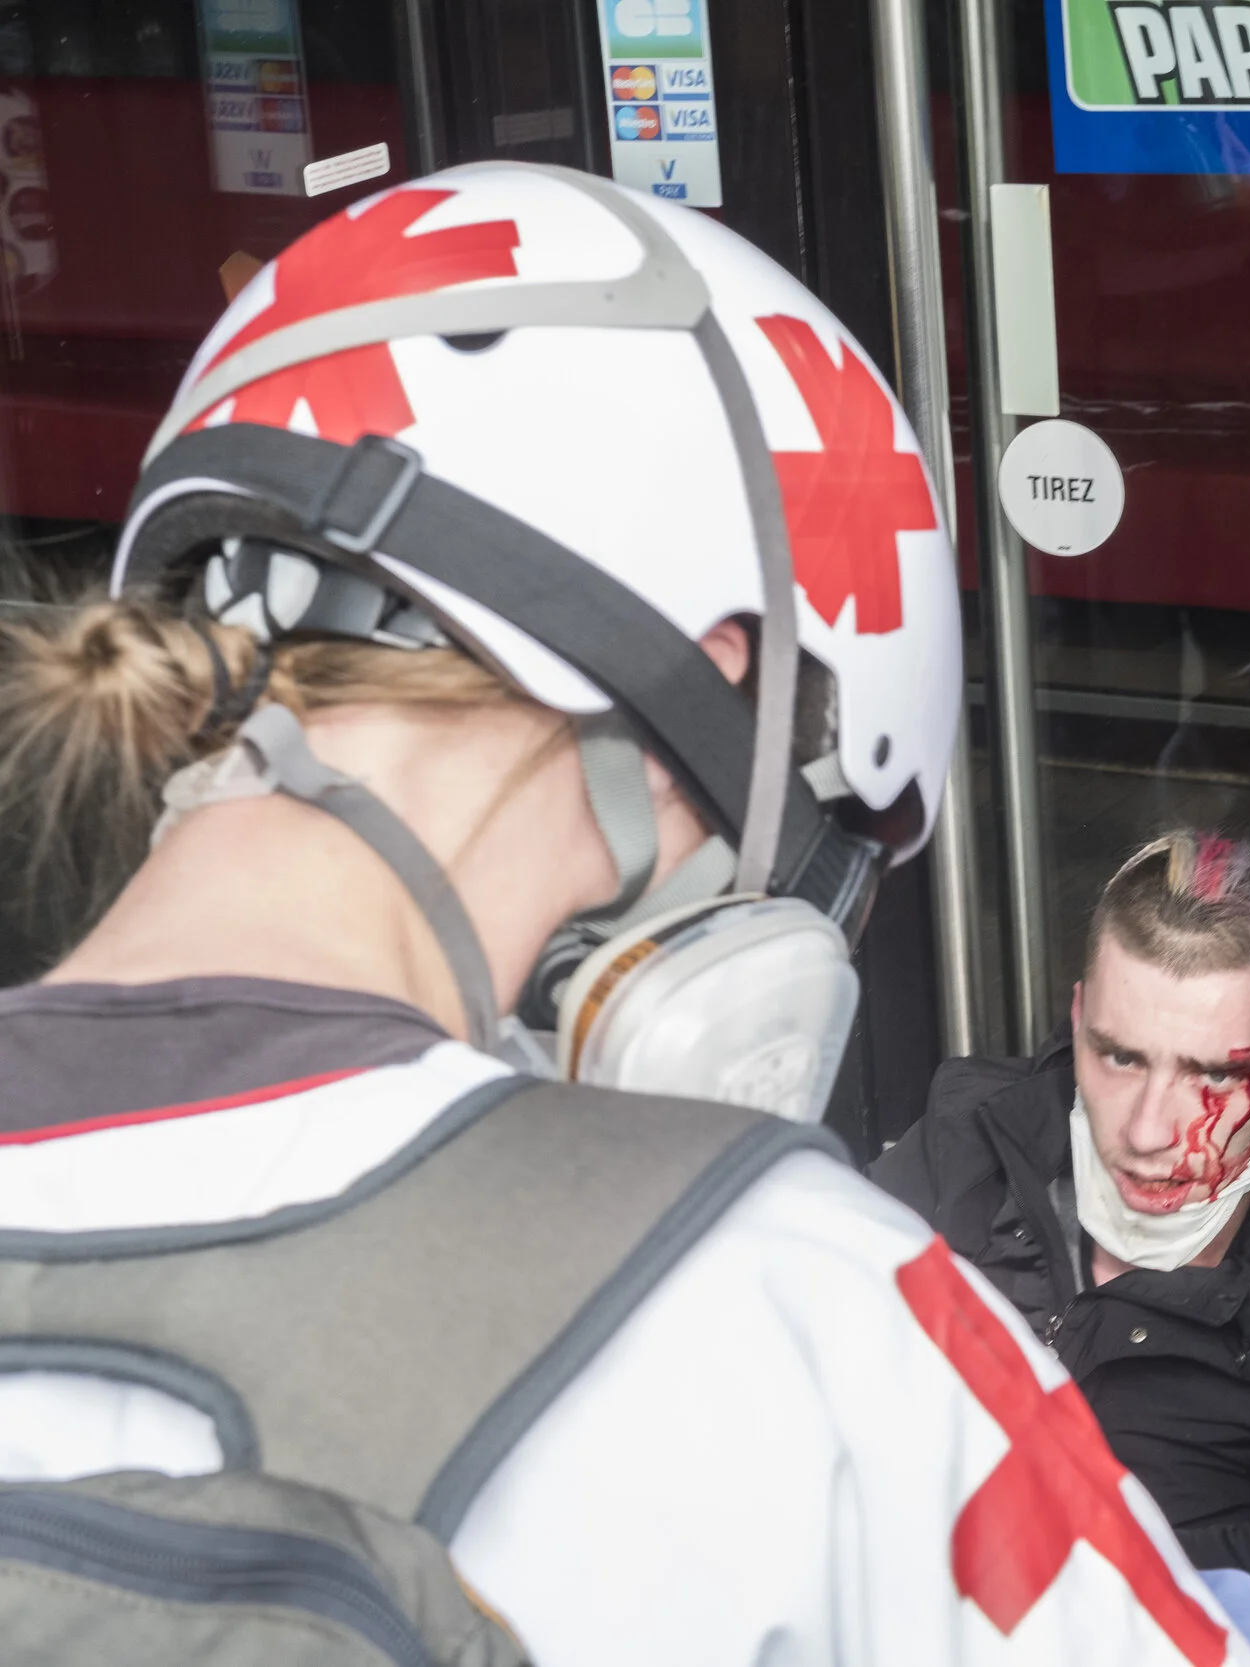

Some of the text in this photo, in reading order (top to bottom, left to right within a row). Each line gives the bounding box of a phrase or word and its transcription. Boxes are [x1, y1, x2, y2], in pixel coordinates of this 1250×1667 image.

[666, 69, 706, 87] VISA
[669, 109, 709, 128] VISA
[1027, 475, 1096, 503] TIREZ
